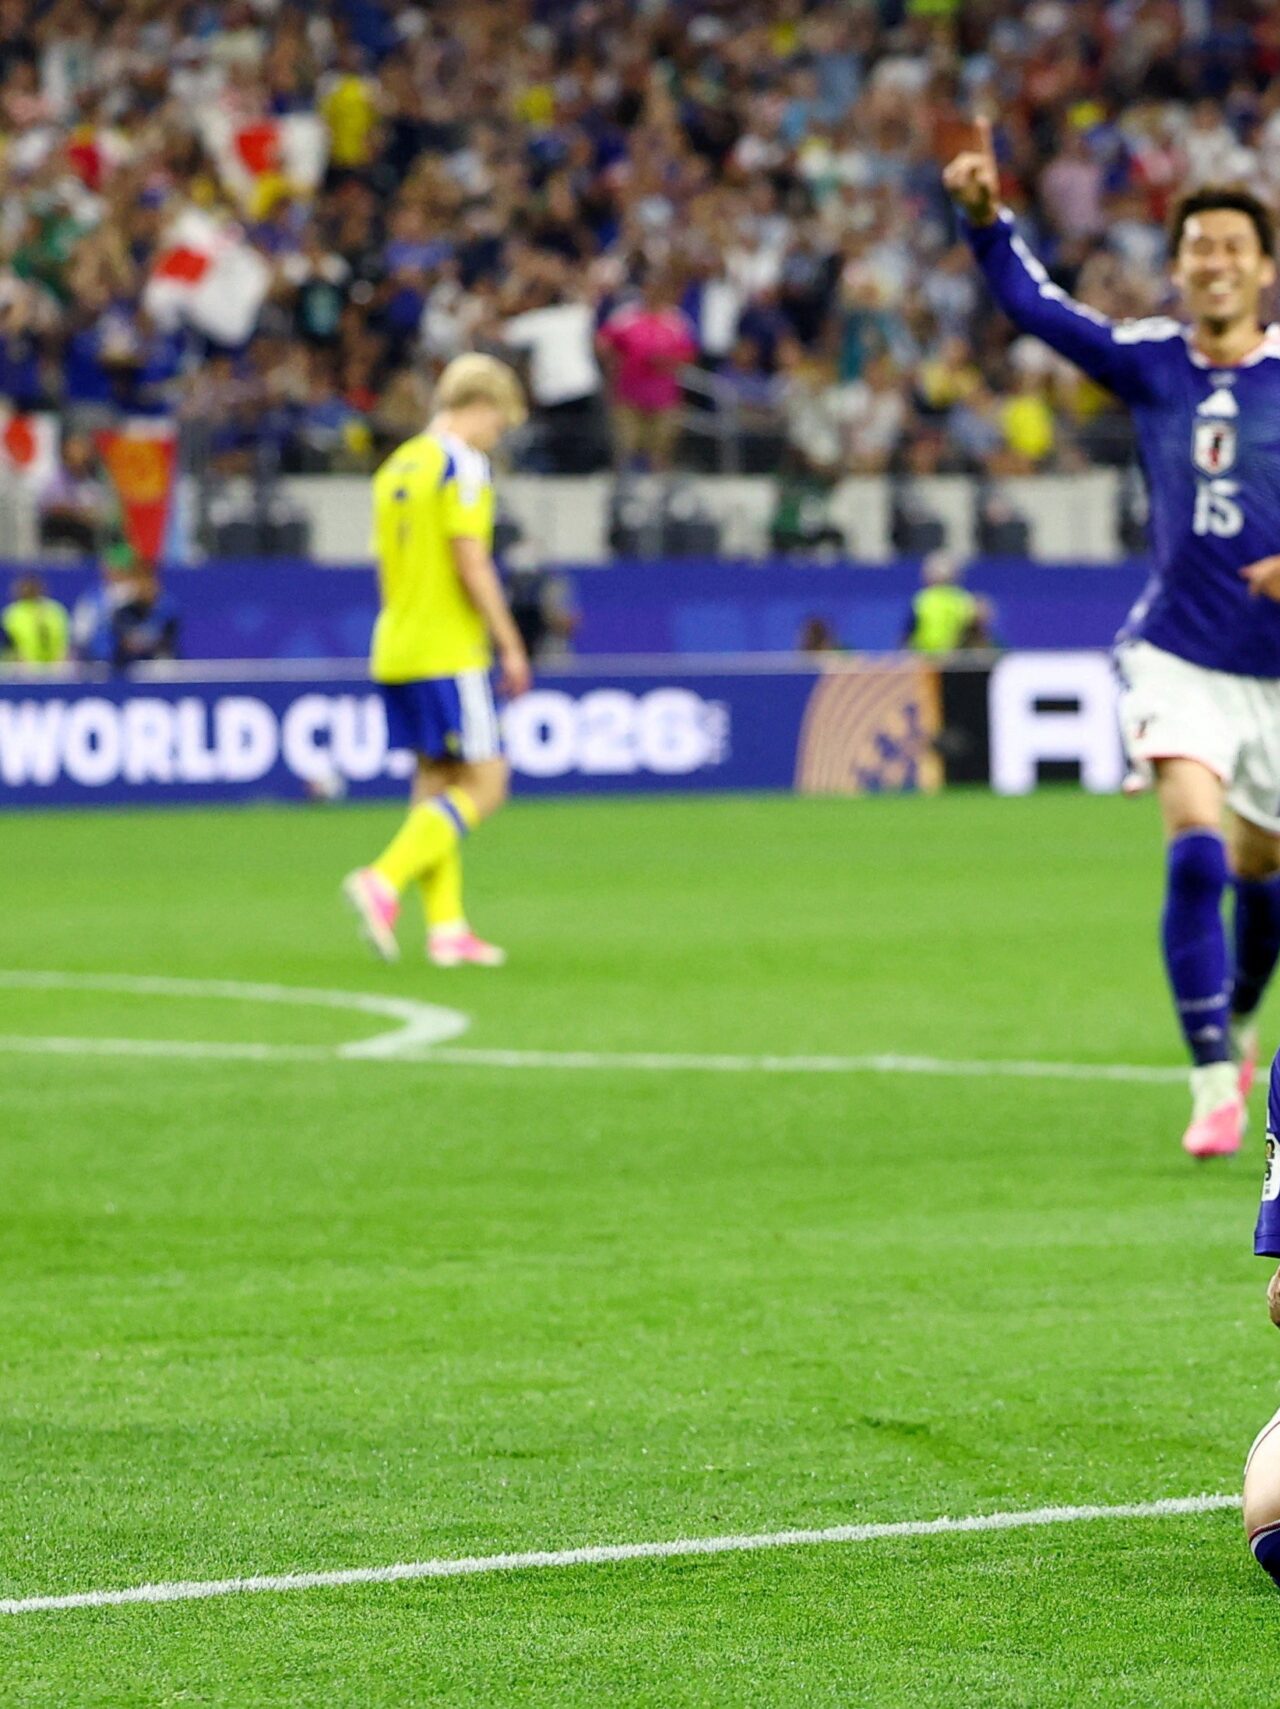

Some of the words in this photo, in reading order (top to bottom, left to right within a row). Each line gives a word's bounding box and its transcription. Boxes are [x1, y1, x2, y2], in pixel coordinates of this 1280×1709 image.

[1193, 479, 1244, 537] 15
[0, 697, 278, 784] WORLD
[282, 694, 419, 780] CU
[503, 688, 708, 774] 026
